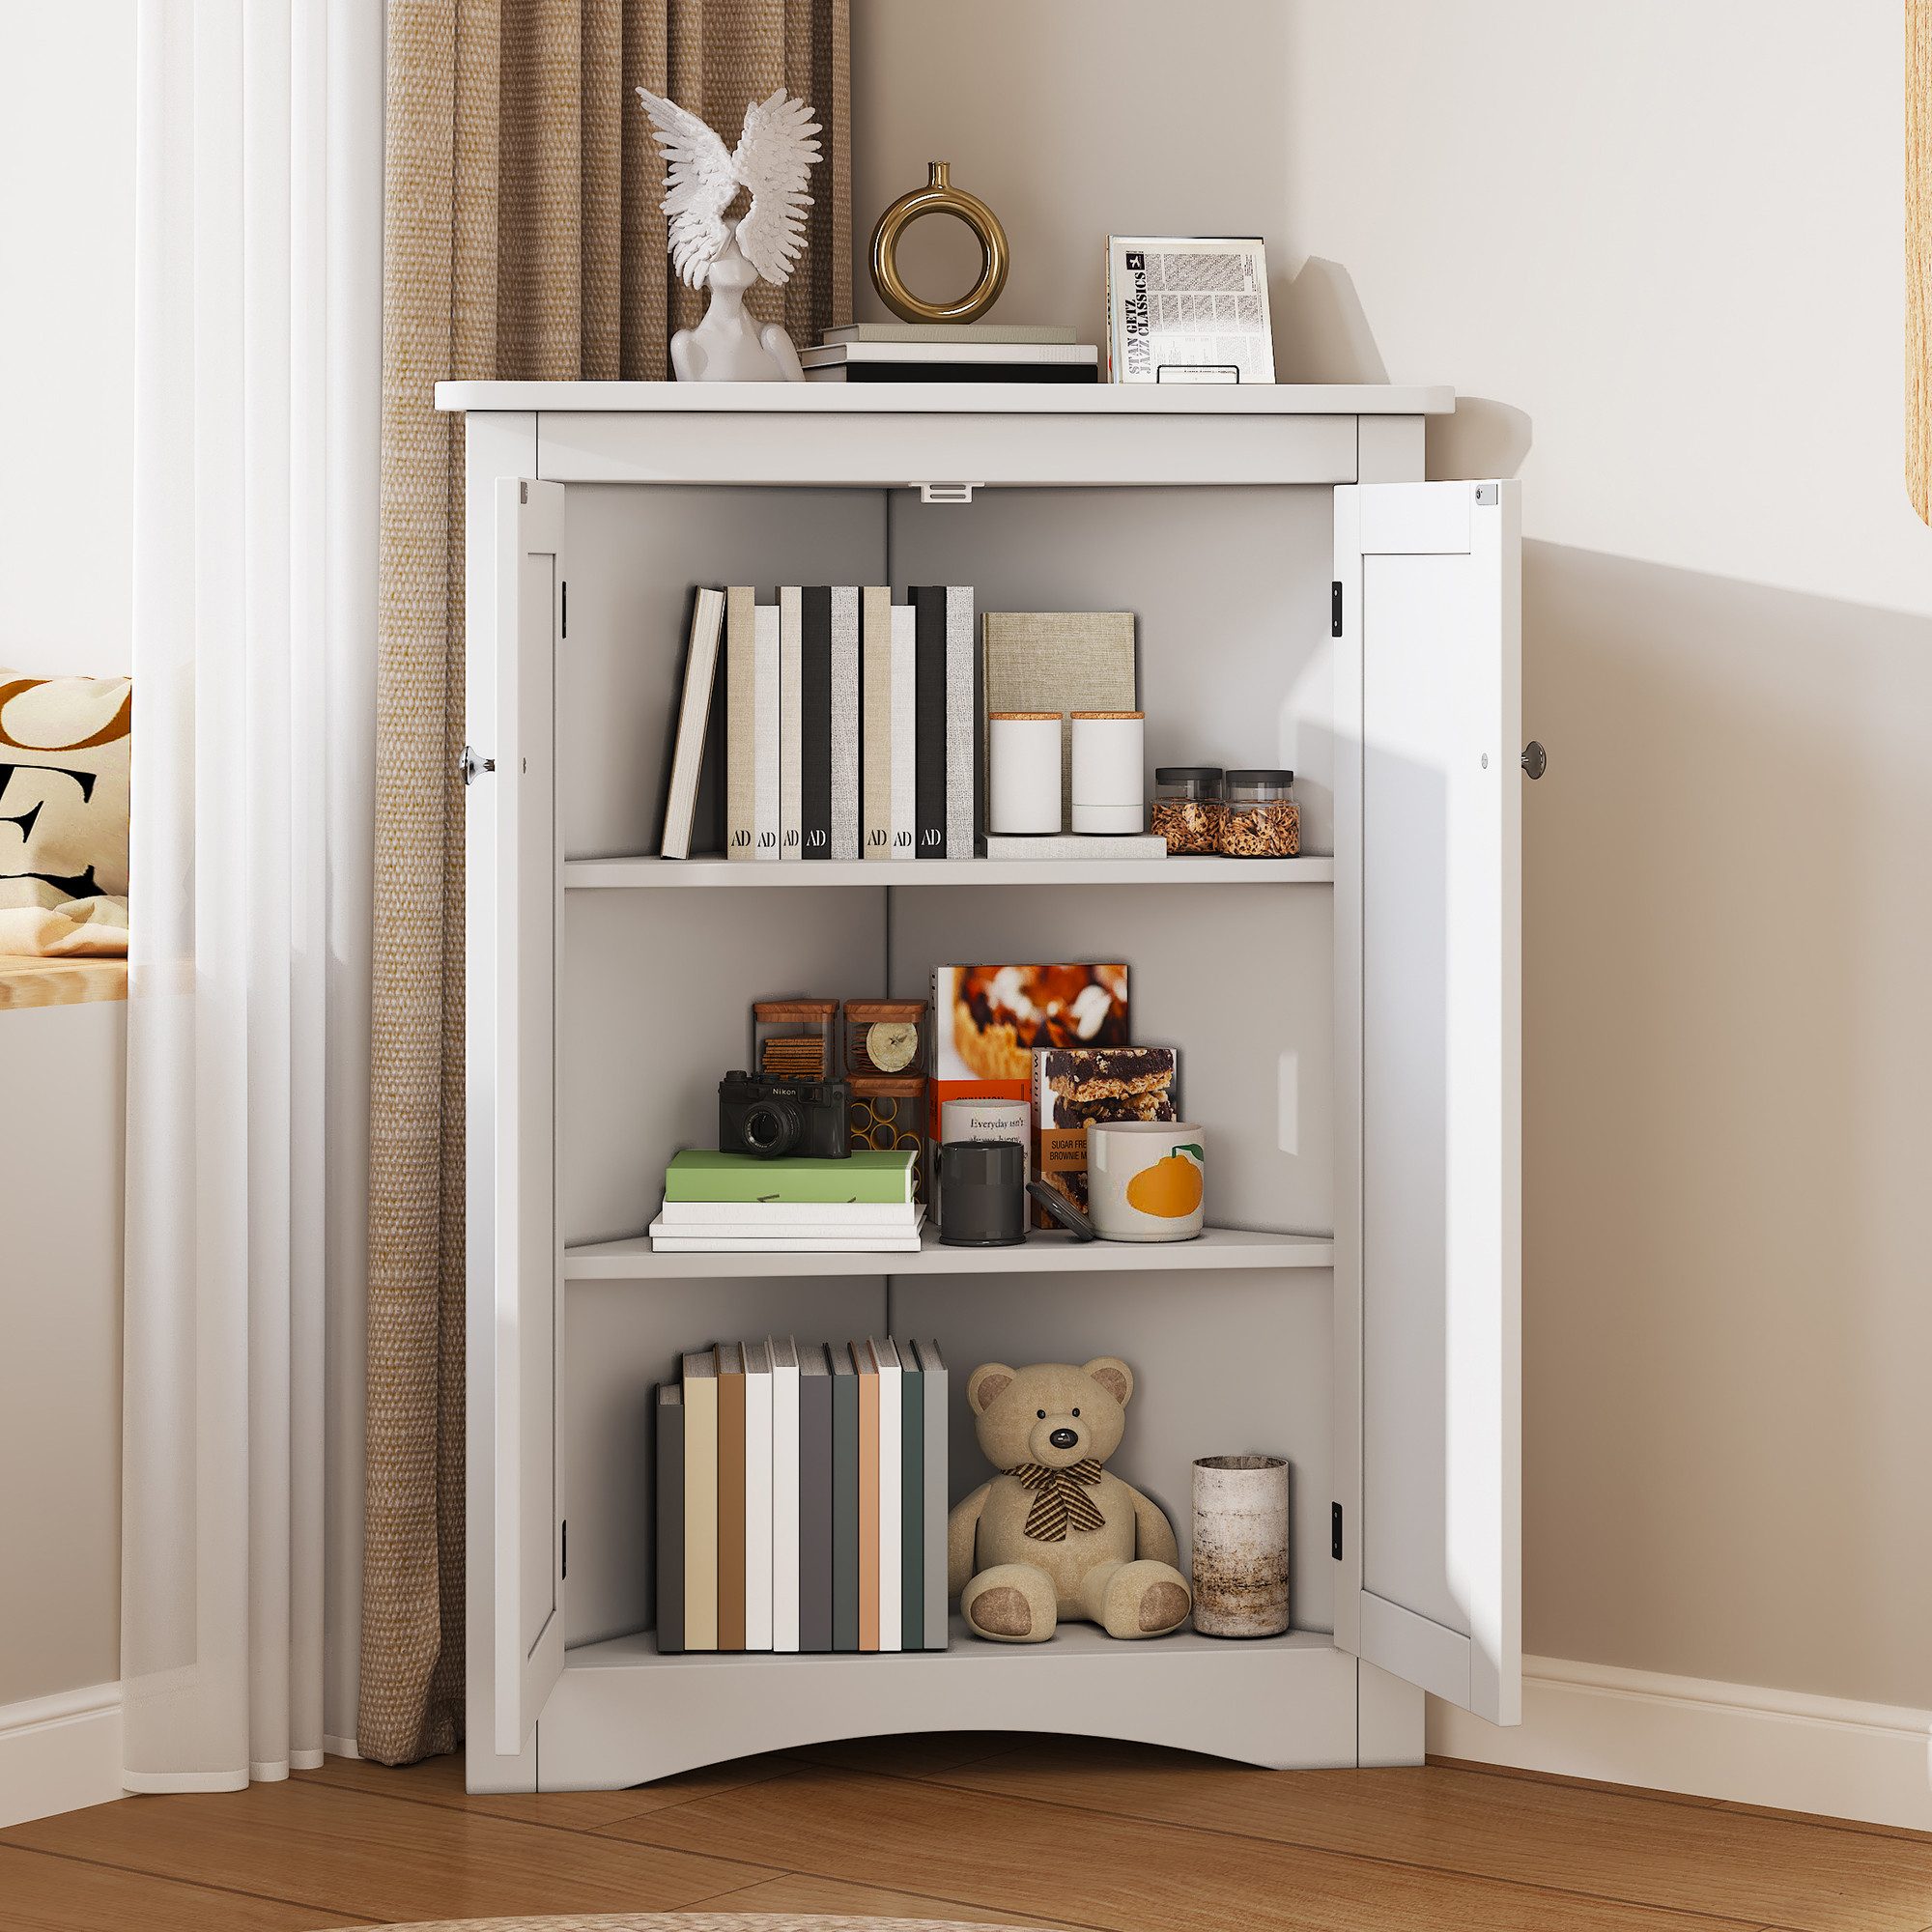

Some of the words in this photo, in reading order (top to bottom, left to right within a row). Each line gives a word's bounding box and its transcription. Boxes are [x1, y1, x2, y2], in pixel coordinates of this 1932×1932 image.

[1135, 271, 1150, 337] CLASSICS
[1125, 298, 1138, 334] GETZ
[1127, 338, 1140, 375] STAN
[1139, 339, 1151, 375] JAZZ
[731, 830, 752, 847] AD
[757, 832, 776, 847] AD
[783, 830, 799, 846] AD
[806, 830, 826, 847] AD
[867, 829, 887, 846] AD
[894, 831, 912, 847] AD
[921, 829, 941, 846] AD
[970, 1119, 1008, 1130] Everyday
[1009, 1117, 1025, 1127] isn't
[1051, 1140, 1073, 1150] SUGAR
[1075, 1140, 1087, 1149] FRE
[1049, 1151, 1079, 1160] BROWNIE
[1080, 1151, 1087, 1160] M
